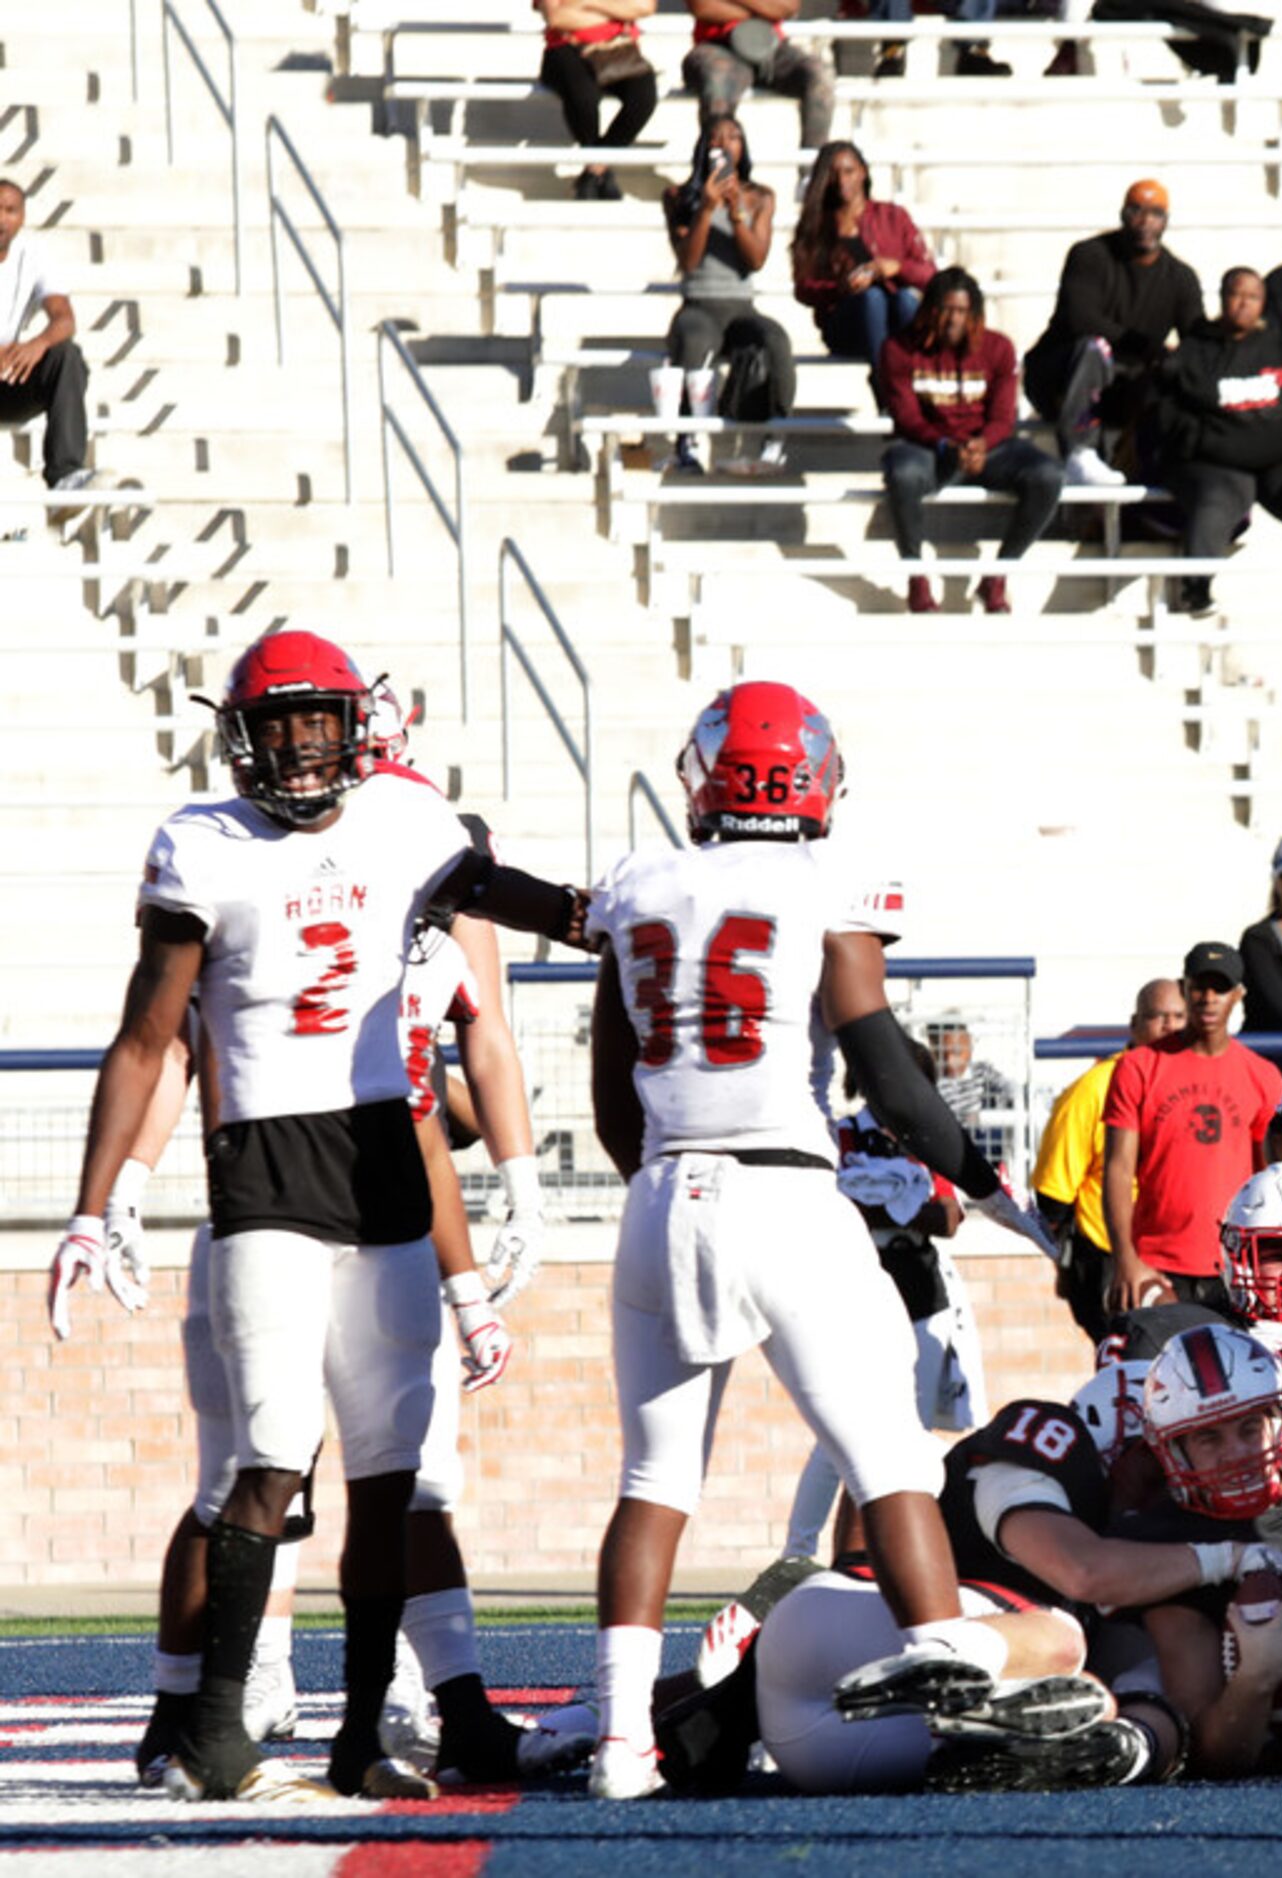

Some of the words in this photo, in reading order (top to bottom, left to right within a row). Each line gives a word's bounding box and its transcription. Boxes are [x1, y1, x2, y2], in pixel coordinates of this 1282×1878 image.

[735, 764, 789, 804] 36
[720, 814, 801, 832] Riddell
[286, 884, 367, 920] HORN
[292, 922, 358, 1036] 2
[627, 909, 777, 1072] 36
[1193, 1104, 1221, 1145] 3
[1005, 1405, 1077, 1463] 18
